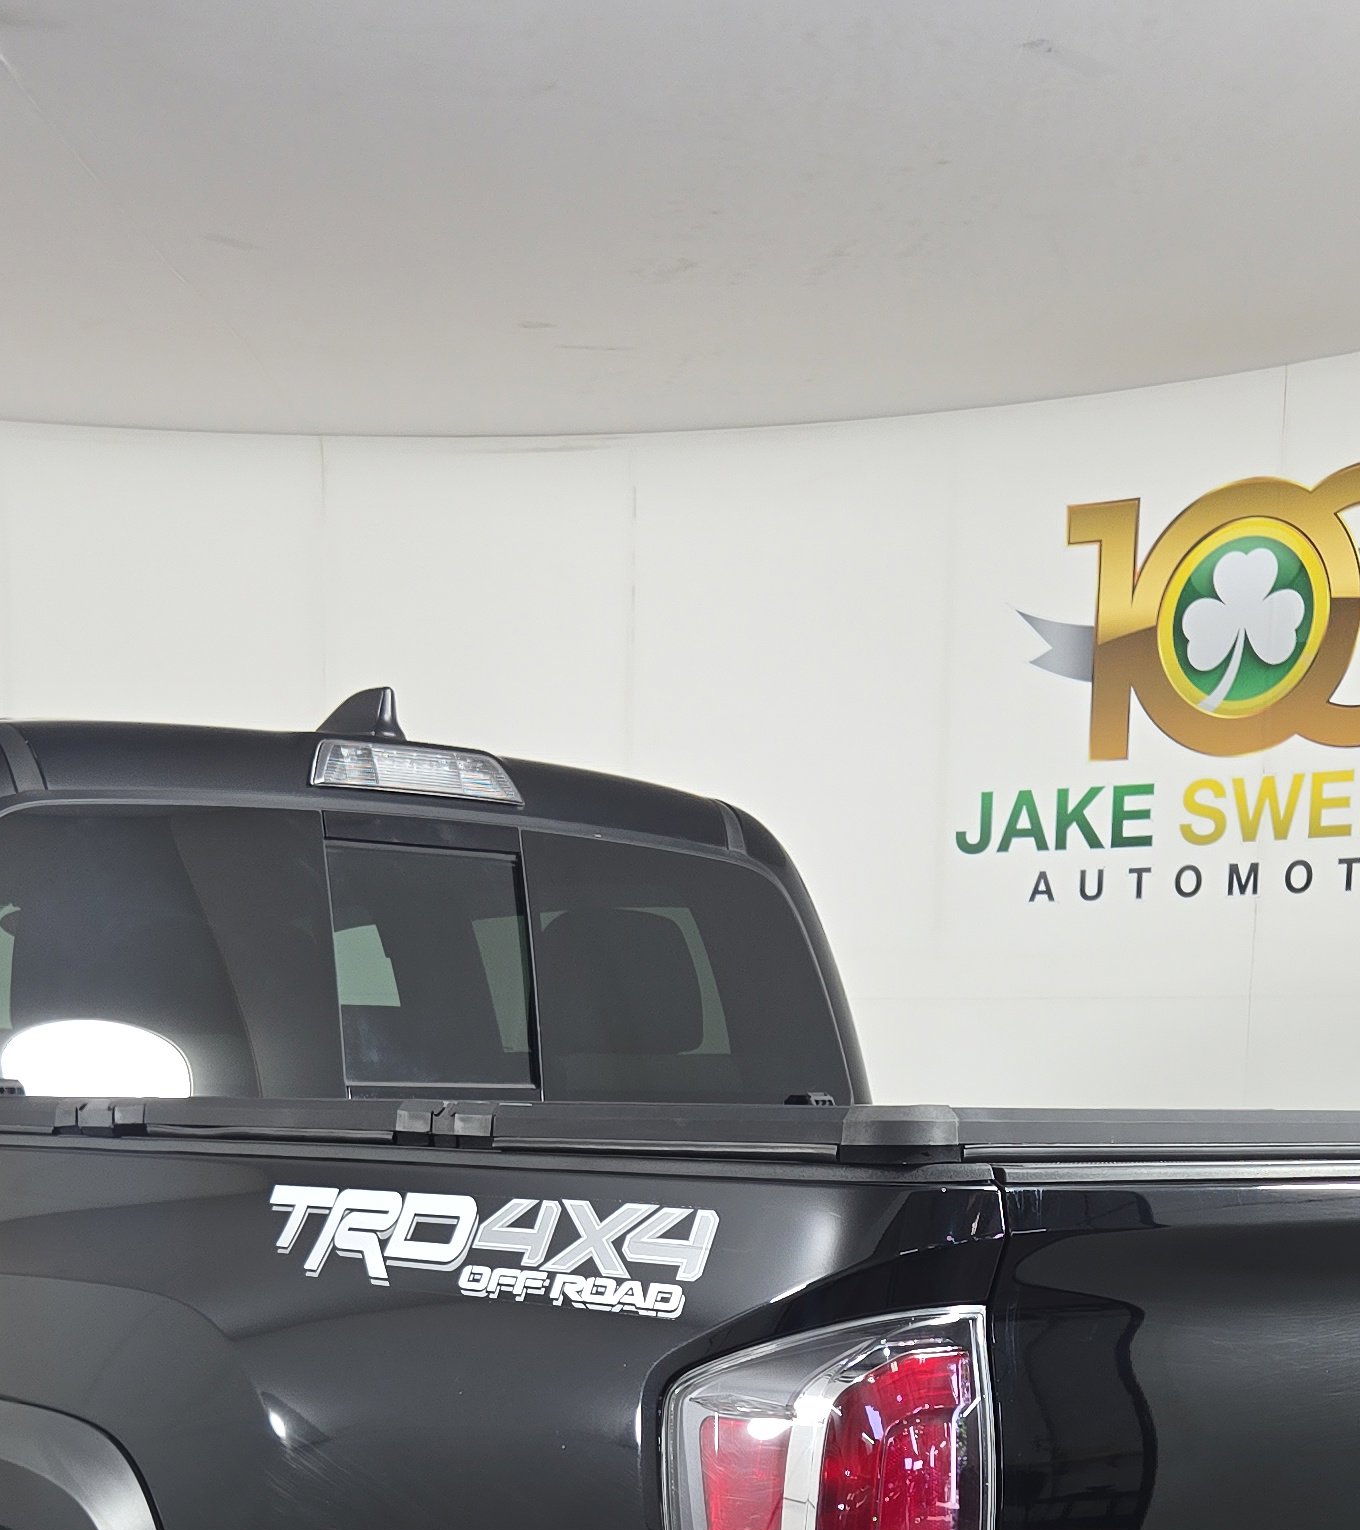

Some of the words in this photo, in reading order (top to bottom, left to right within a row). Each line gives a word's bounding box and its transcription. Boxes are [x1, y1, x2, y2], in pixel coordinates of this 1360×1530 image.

[955, 783, 1155, 855] JAKE
[270, 1184, 479, 1287] TRD
[472, 1198, 720, 1282] 4X4
[458, 1265, 550, 1302] OFF
[550, 1273, 687, 1320] ROAD
